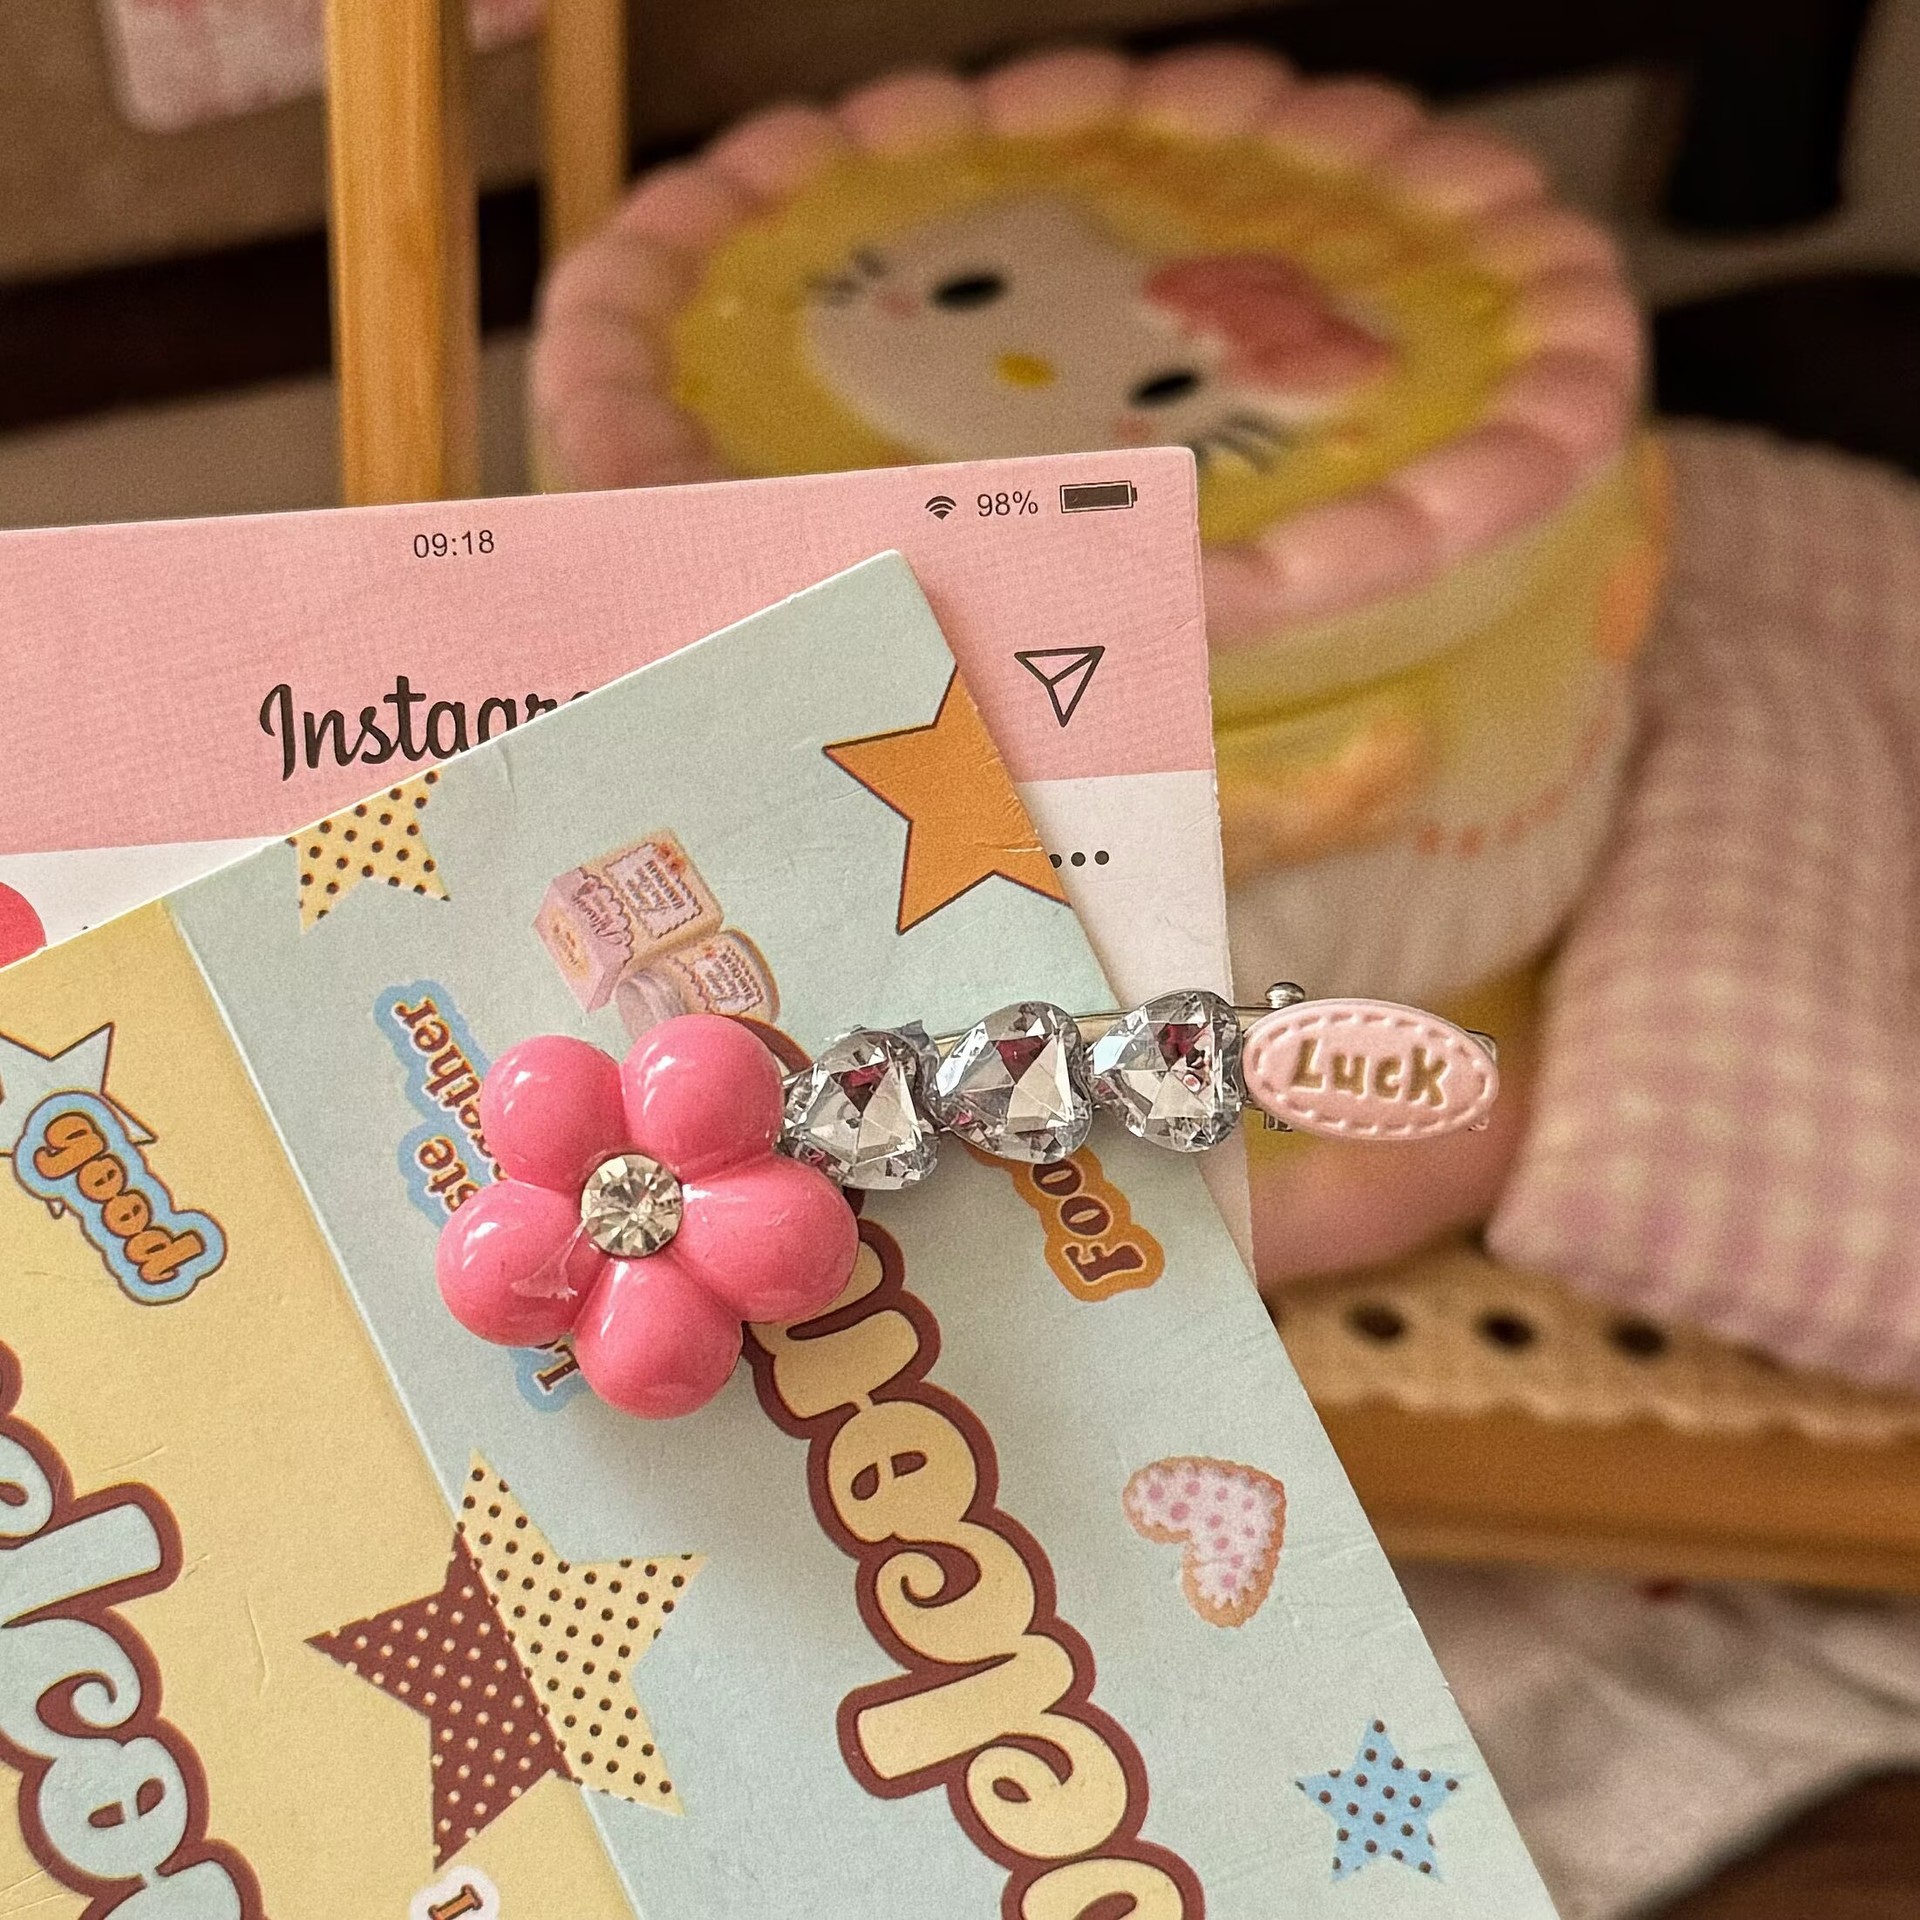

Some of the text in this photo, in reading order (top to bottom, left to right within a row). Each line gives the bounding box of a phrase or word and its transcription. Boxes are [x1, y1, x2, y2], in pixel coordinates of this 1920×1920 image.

[976, 490, 1039, 517] 98%
[412, 529, 495, 559] 09:18
[259, 674, 592, 782] Insta
[33, 1110, 206, 1285] good
